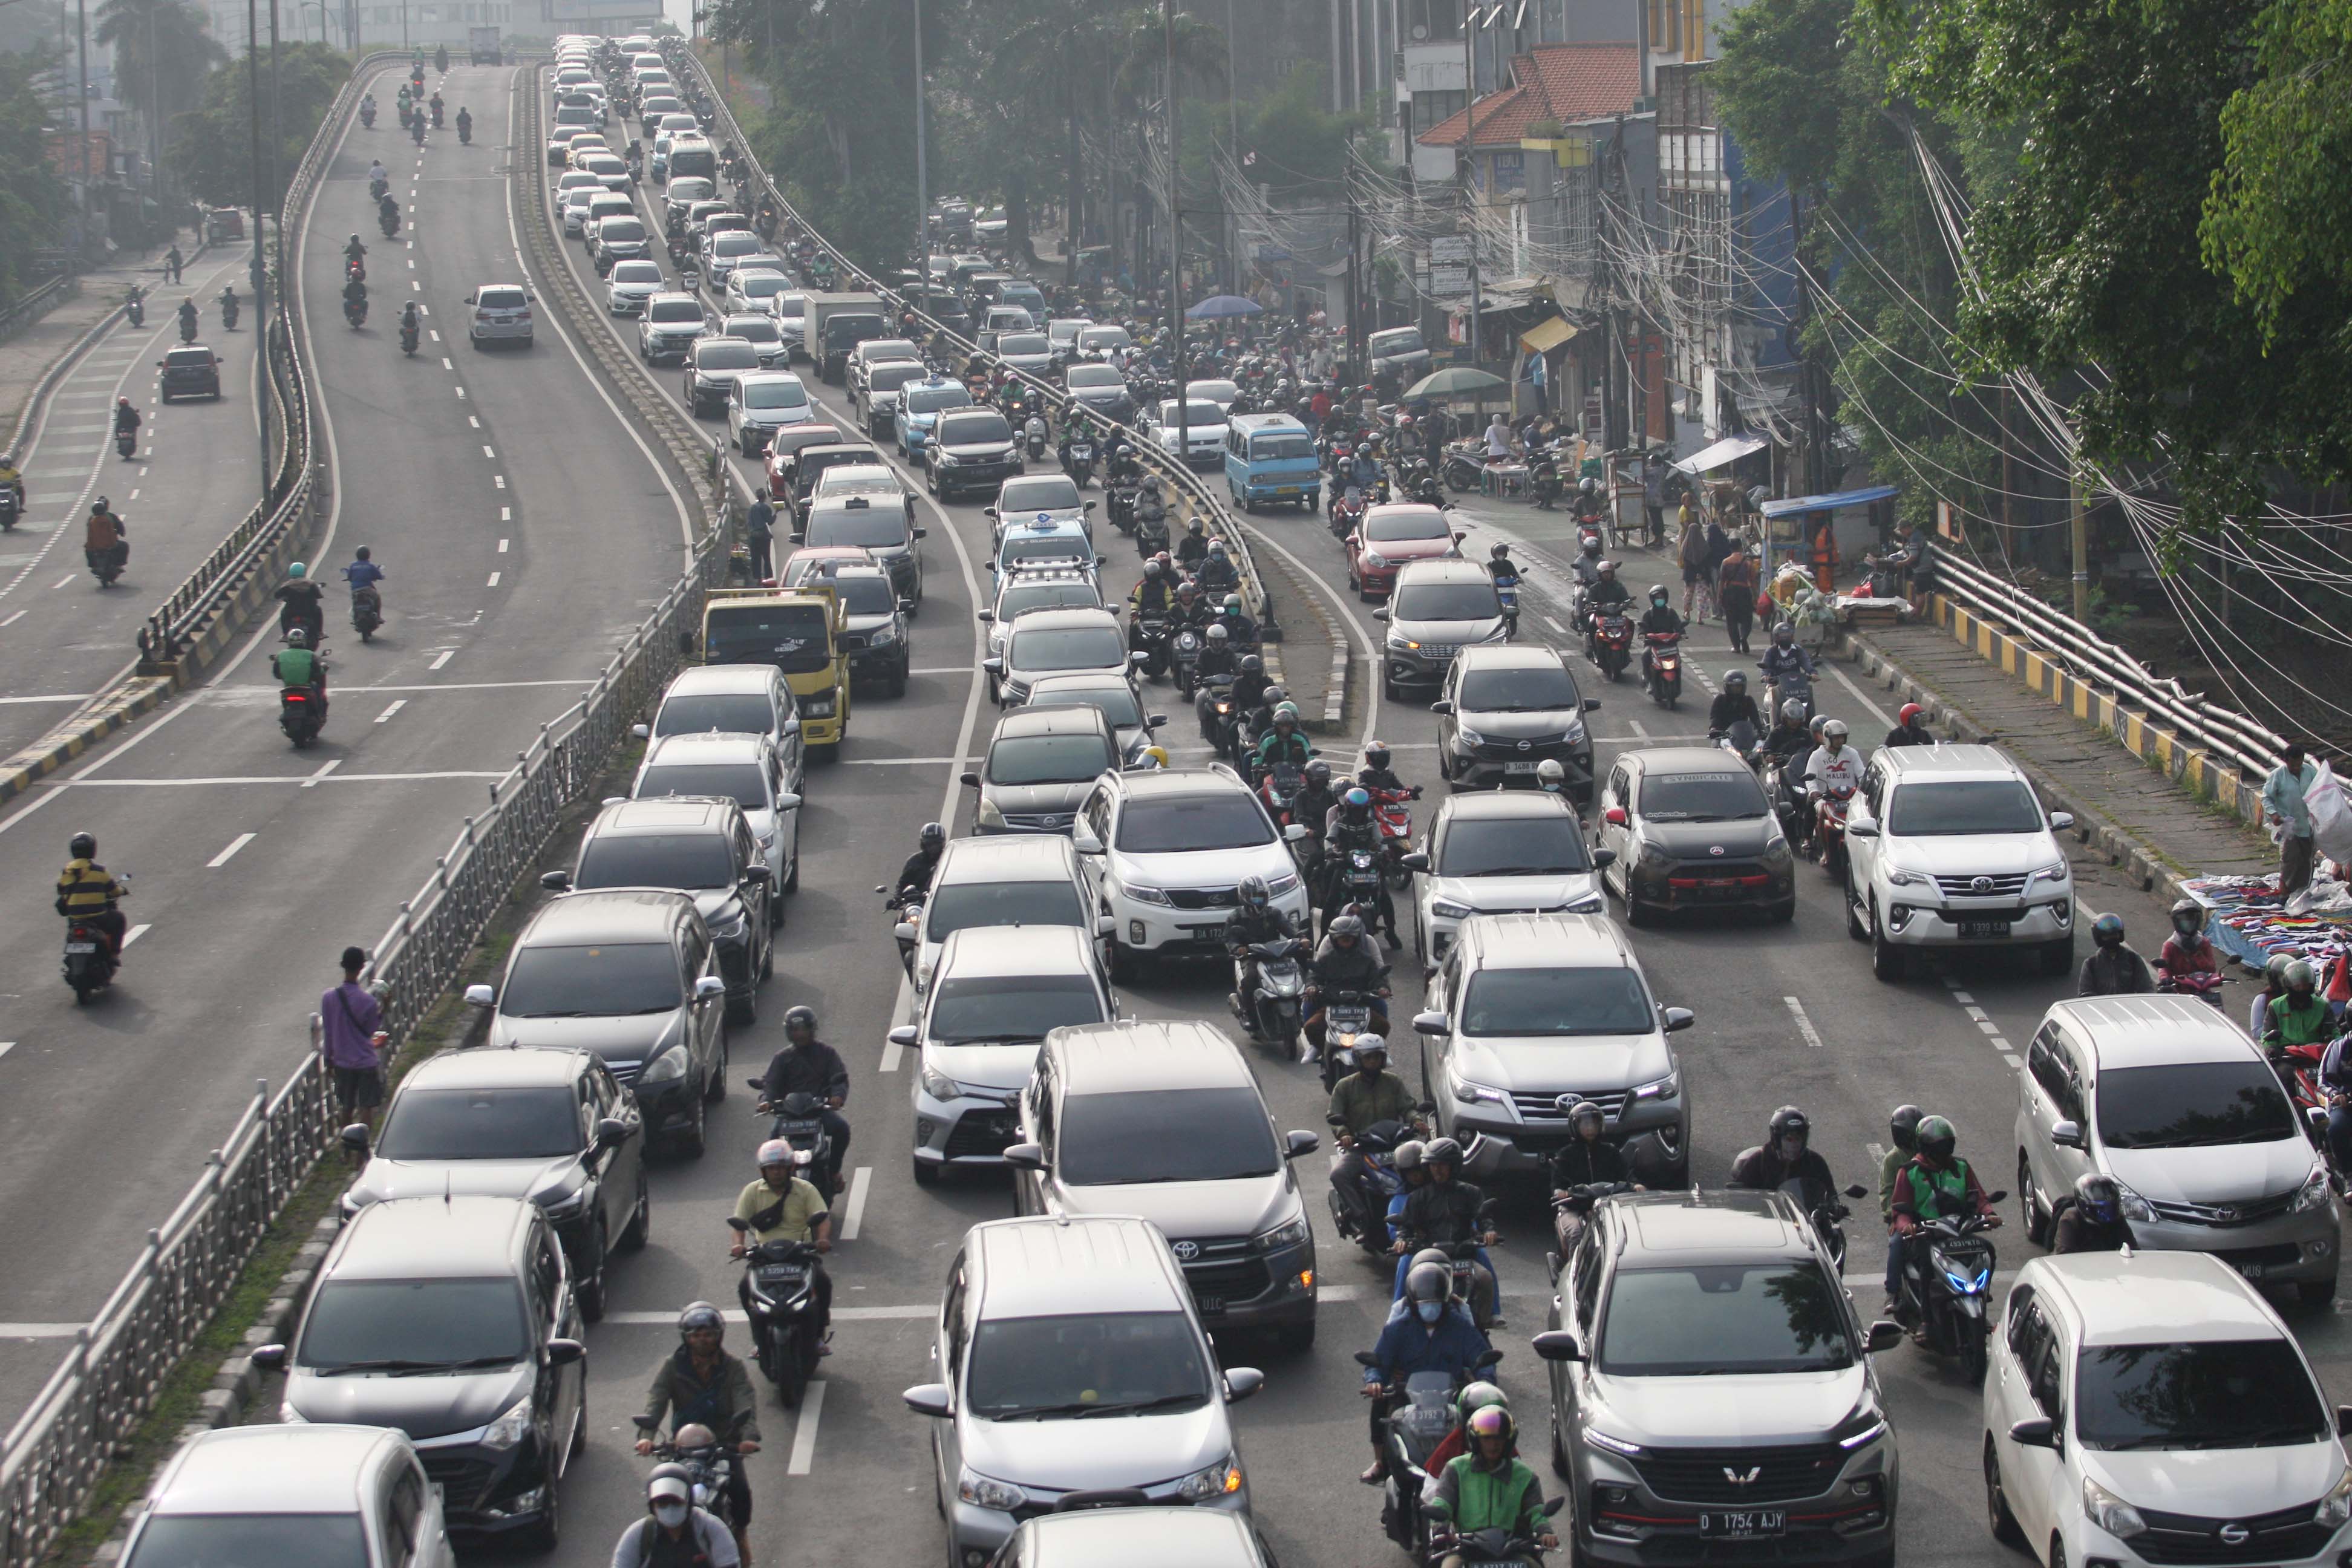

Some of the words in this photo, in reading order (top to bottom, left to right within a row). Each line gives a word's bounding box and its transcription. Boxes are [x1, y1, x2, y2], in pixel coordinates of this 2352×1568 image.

[1776, 658, 1797, 668] PARIS
[1961, 923, 1965, 932] B
[1973, 923, 1990, 932] 1339
[1701, 1514, 1709, 1530] D
[1724, 1514, 1753, 1529] 1754
[1761, 1512, 1783, 1528] AJY
